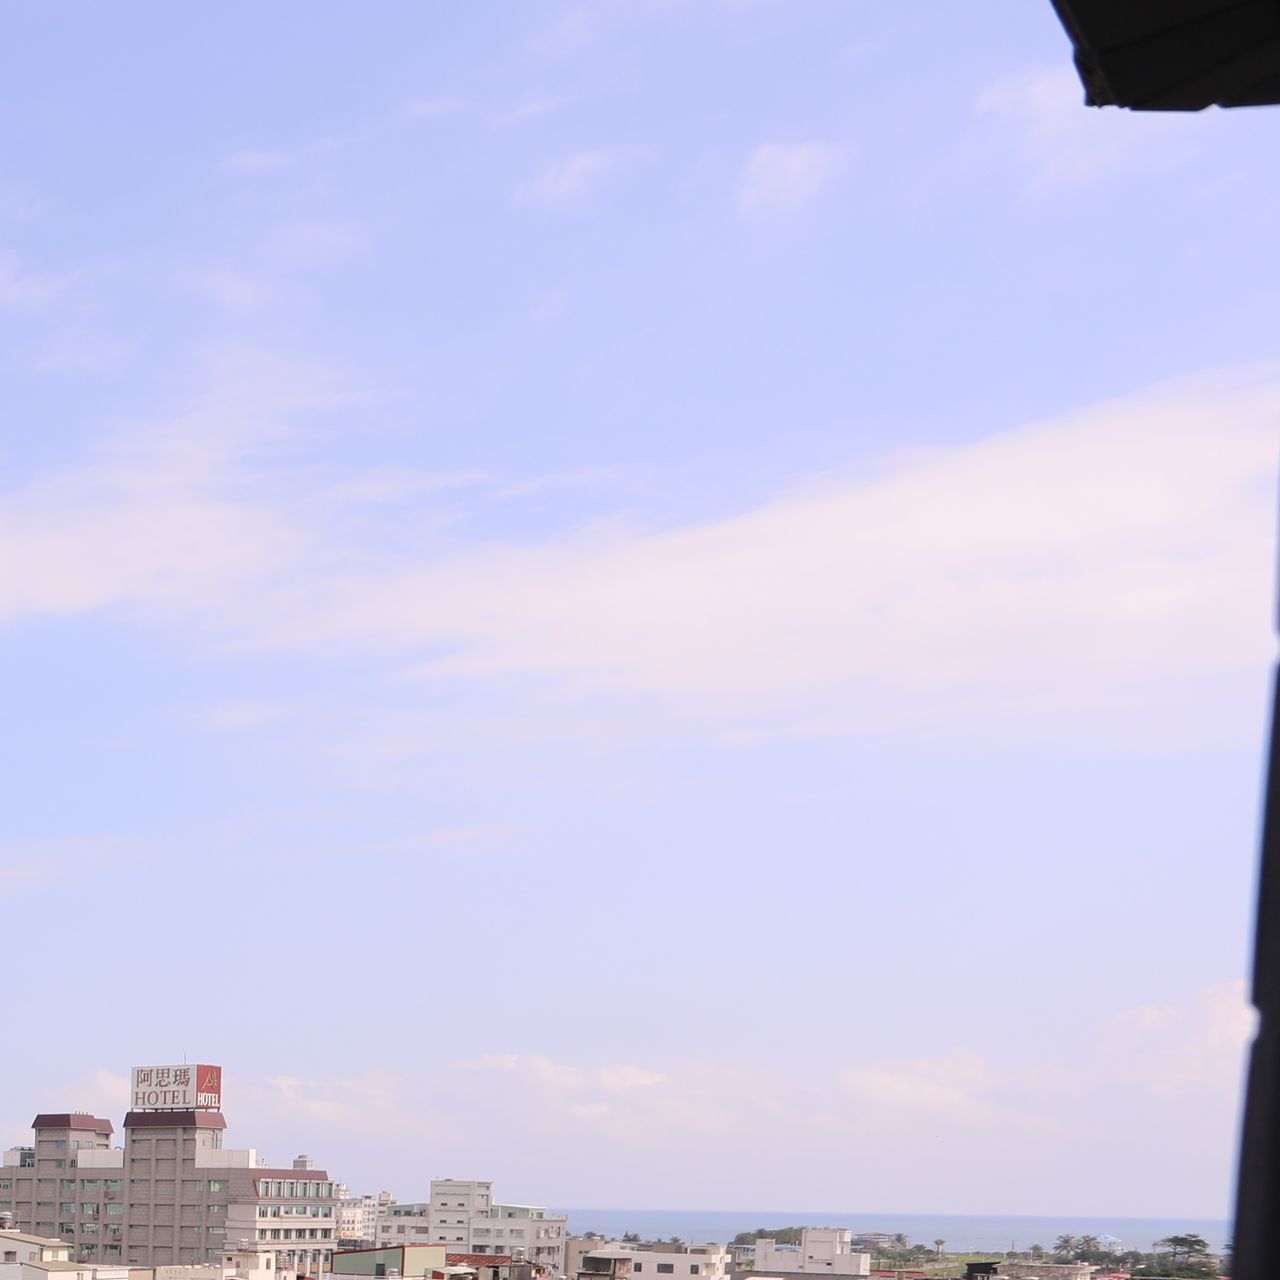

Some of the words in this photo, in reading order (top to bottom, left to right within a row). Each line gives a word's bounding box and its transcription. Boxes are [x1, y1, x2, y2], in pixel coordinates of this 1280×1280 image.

[136, 1068, 190, 1088] 阿思瑪
[135, 1089, 191, 1106] HOTEL
[197, 1092, 219, 1107] HOTEL
